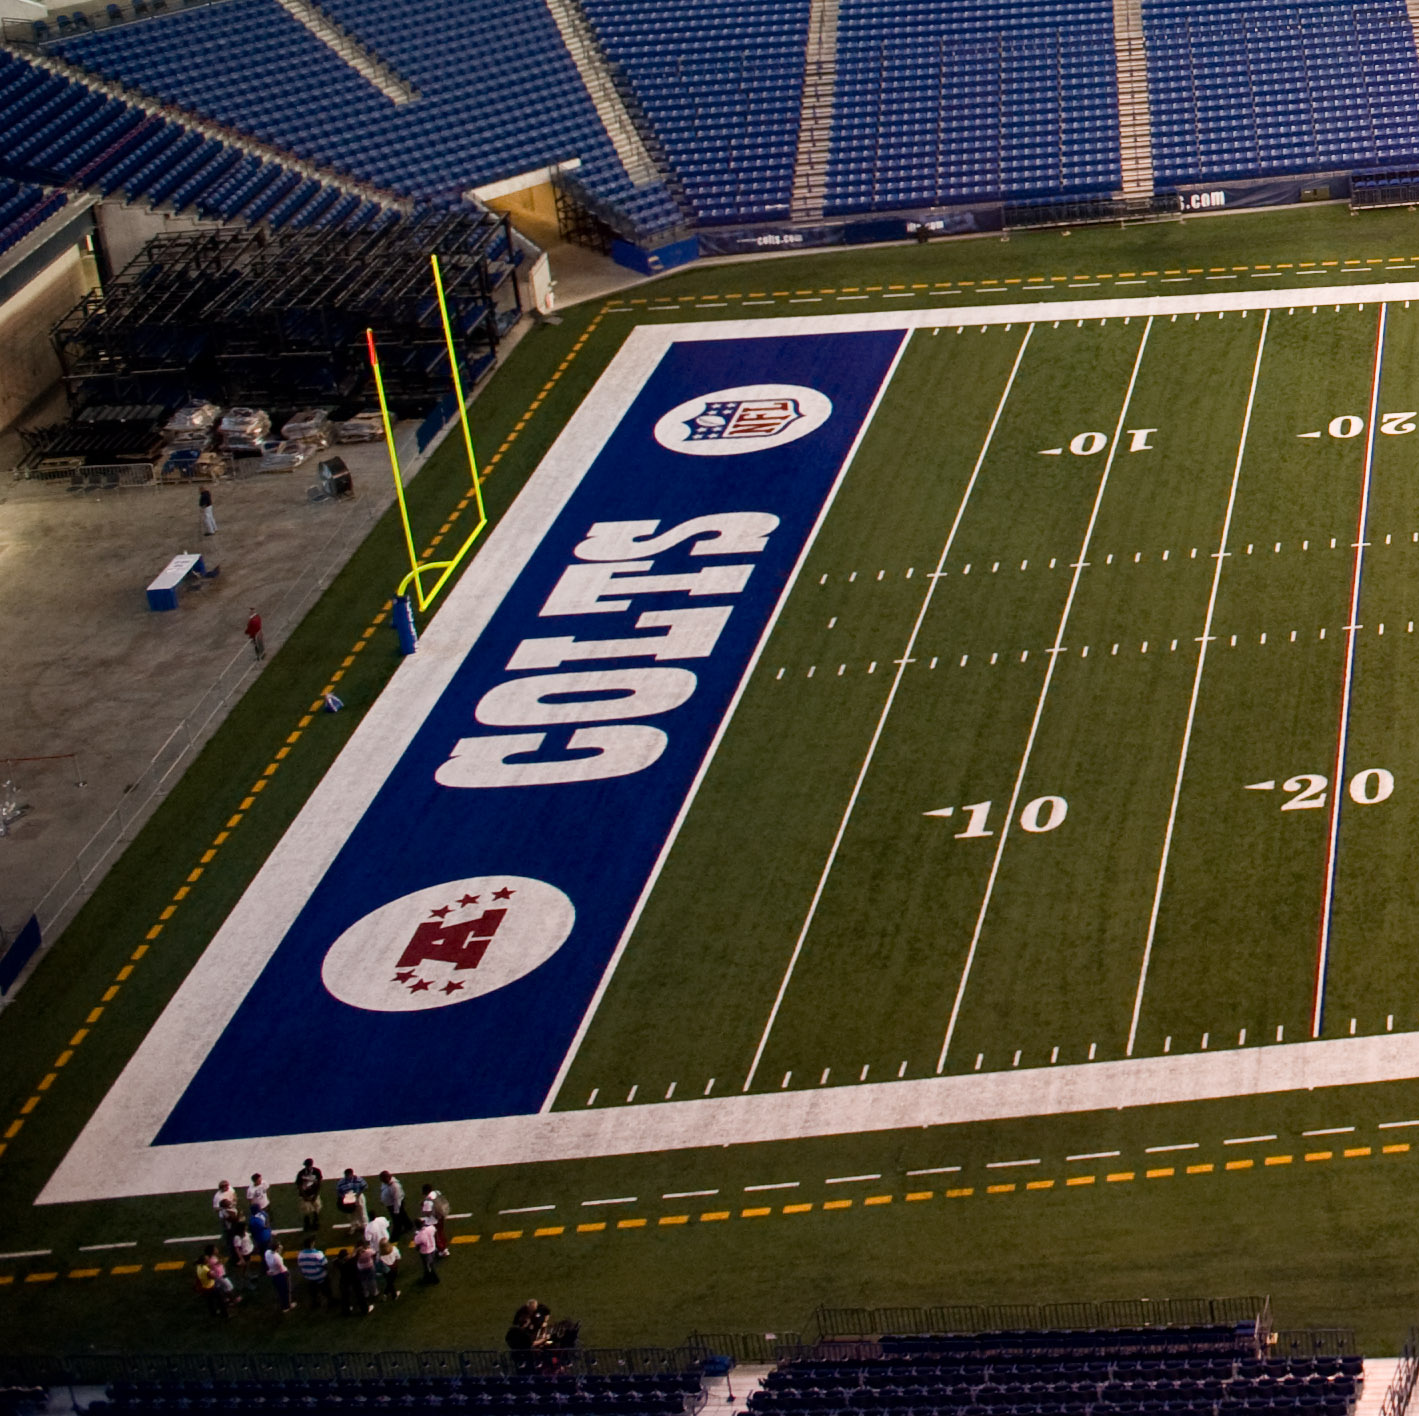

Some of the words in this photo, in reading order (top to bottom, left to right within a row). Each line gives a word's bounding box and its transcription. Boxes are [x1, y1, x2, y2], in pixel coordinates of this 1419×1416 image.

[757, 234, 803, 246] colts.com
[728, 401, 792, 436] NFL
[1328, 411, 1418, 439] 20
[1069, 428, 1156, 456] 10
[434, 510, 780, 789] COLTS
[1280, 767, 1395, 812] 20
[955, 794, 1069, 840] 10
